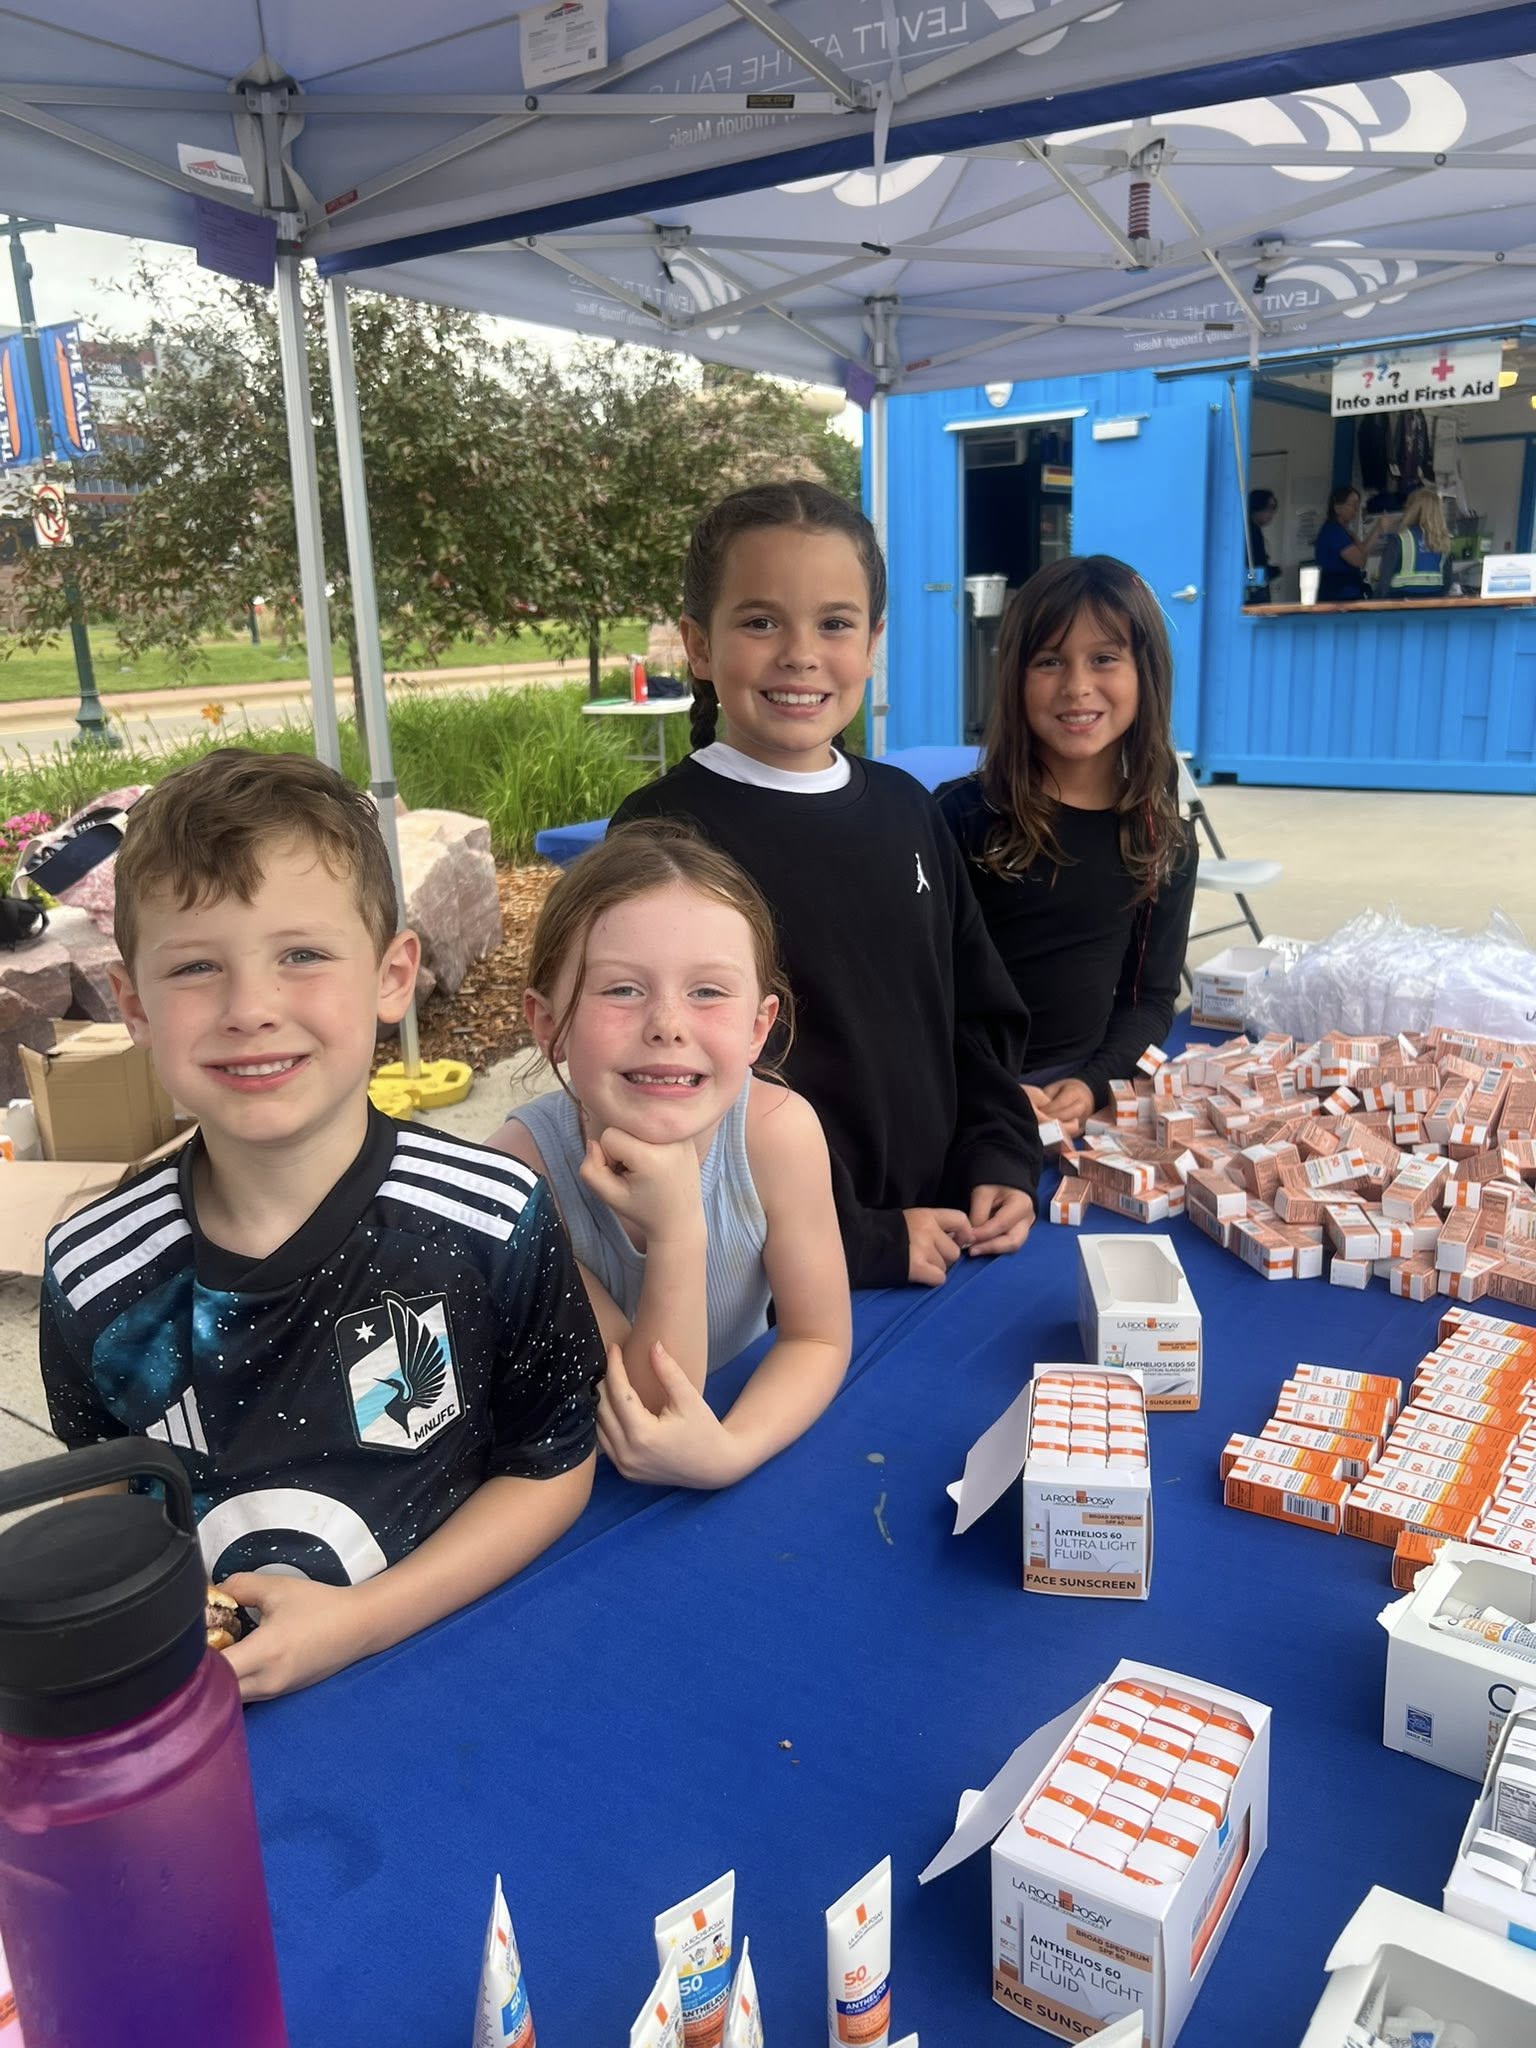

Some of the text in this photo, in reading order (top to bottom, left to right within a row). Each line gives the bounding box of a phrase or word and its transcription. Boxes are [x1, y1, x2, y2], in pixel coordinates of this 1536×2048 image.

[66, 327, 96, 451] THE FALLS
[1336, 381, 1494, 410] Info and First Aid
[413, 1403, 457, 1442] MNUFC
[1040, 1493, 1052, 1502] LA
[1087, 1496, 1116, 1505] POSAY
[1054, 1538, 1137, 1552] ULTRA LIGHT
[1055, 1528, 1122, 1540] ANTHELIOS 60
[1054, 1548, 1092, 1561] FLUID
[1026, 1573, 1137, 1590] FACE SUNSCREEN
[1012, 1877, 1028, 1892] LA
[1028, 1883, 1072, 1912] ROCHE
[1071, 1903, 1113, 1928] POSAY
[1031, 1934, 1121, 1980] ANTHELIOS 60
[1076, 1928, 1150, 1963] BROAD SPECTRUM
[1098, 1946, 1114, 1958] SPF
[680, 1974, 703, 1996] 50
[844, 1964, 867, 1987] 50
[1030, 1945, 1144, 2003] ULTRA LIGHT
[1030, 1961, 1080, 1993] FLUID
[846, 1980, 887, 2010] ANTHELIOS
[995, 1980, 1101, 2038] FACE SUNSC
